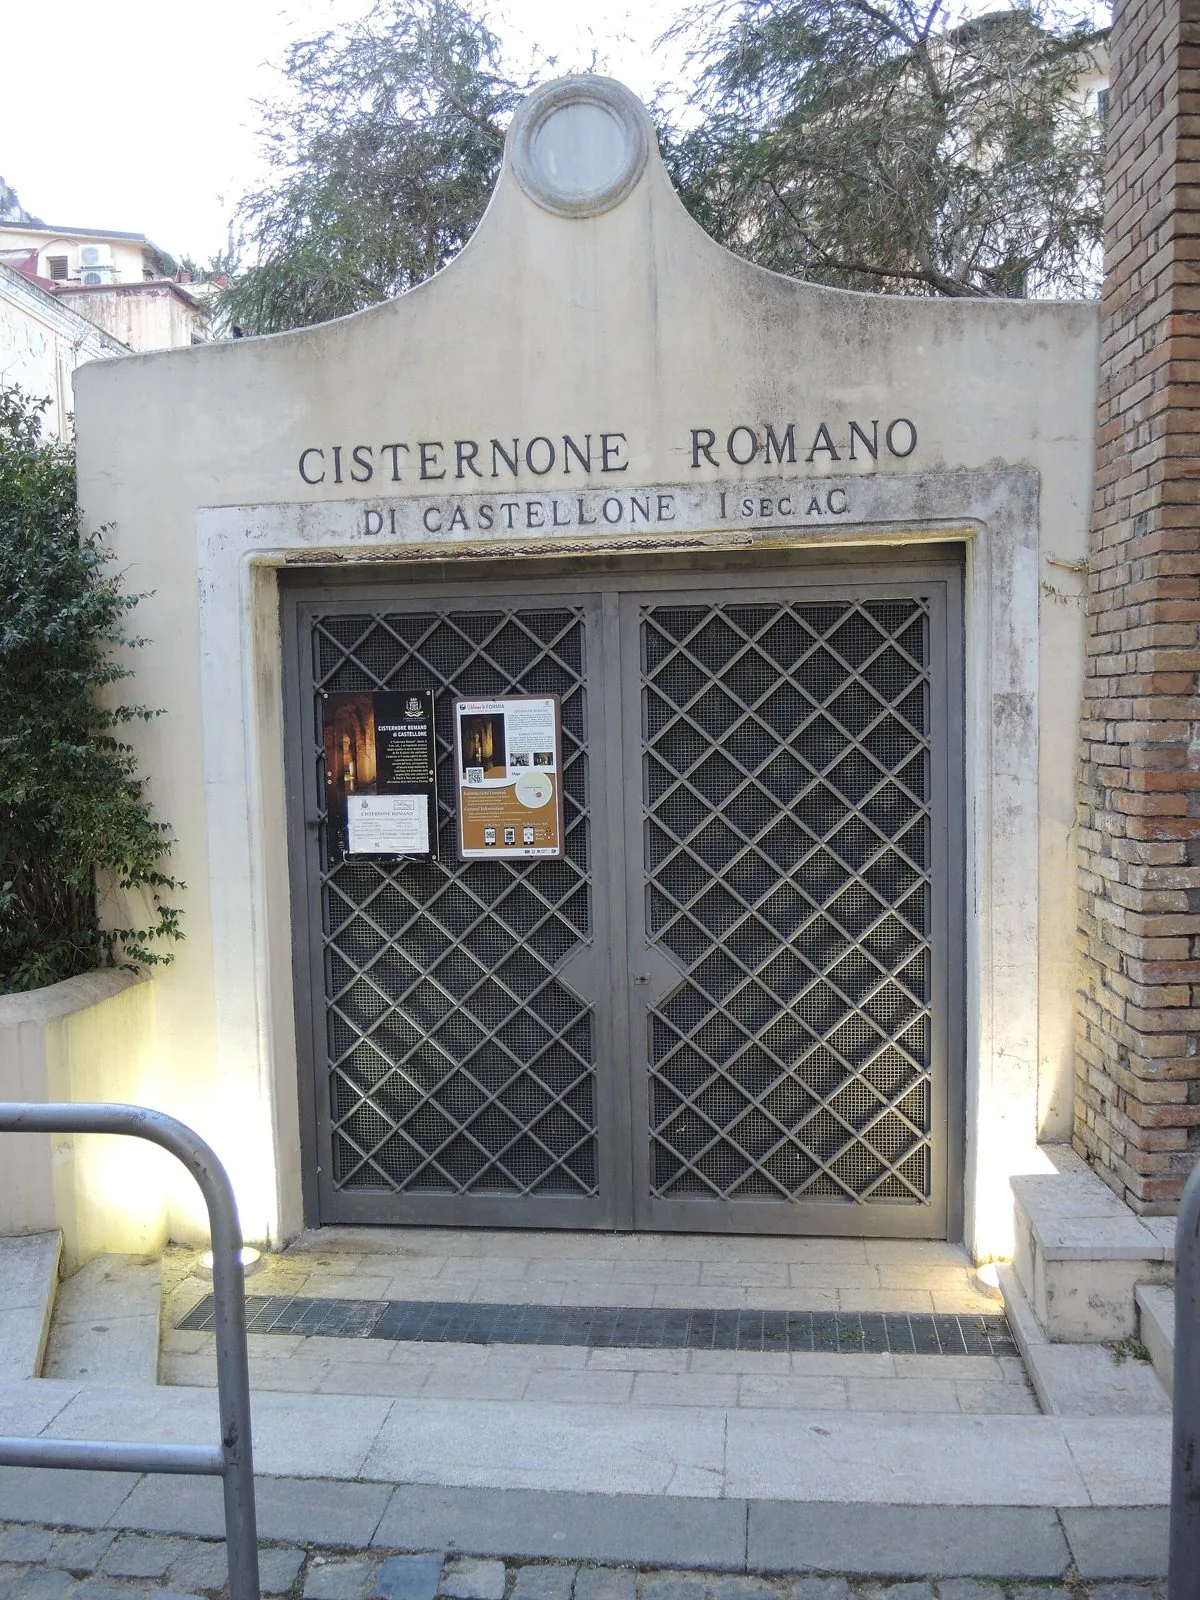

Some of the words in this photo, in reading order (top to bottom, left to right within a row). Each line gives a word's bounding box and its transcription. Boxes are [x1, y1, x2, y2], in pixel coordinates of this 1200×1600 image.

[298, 432, 630, 485] CISTERNONE
[690, 417, 918, 468] ROMANO
[363, 508, 397, 536] DI
[422, 494, 676, 533] CASTELLONE
[718, 491, 728, 519] I
